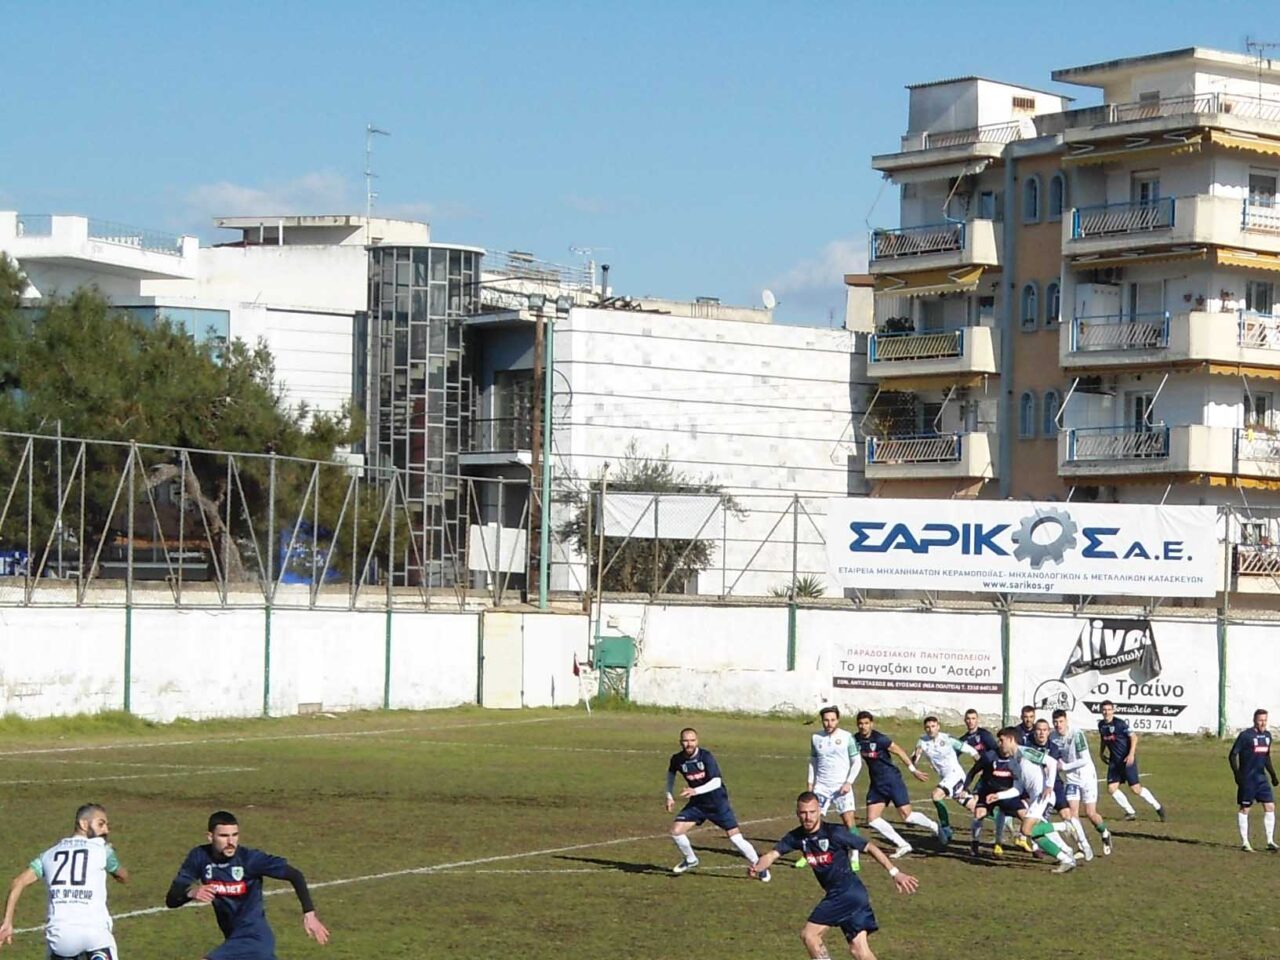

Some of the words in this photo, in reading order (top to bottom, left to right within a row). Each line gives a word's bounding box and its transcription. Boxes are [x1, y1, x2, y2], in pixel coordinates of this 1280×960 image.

[1122, 541, 1193, 562] Α.Ε.
[838, 566, 875, 575] ΕΤΑΙΡΕΙΑ
[983, 580, 1055, 592] www.sarikos.gr
[858, 662, 912, 675] μαγαζάκι
[916, 666, 937, 675] του
[1116, 678, 1184, 700] Τραίνο
[1133, 719, 1152, 729] 653
[1155, 720, 1173, 731] 741
[51, 849, 89, 886] 20
